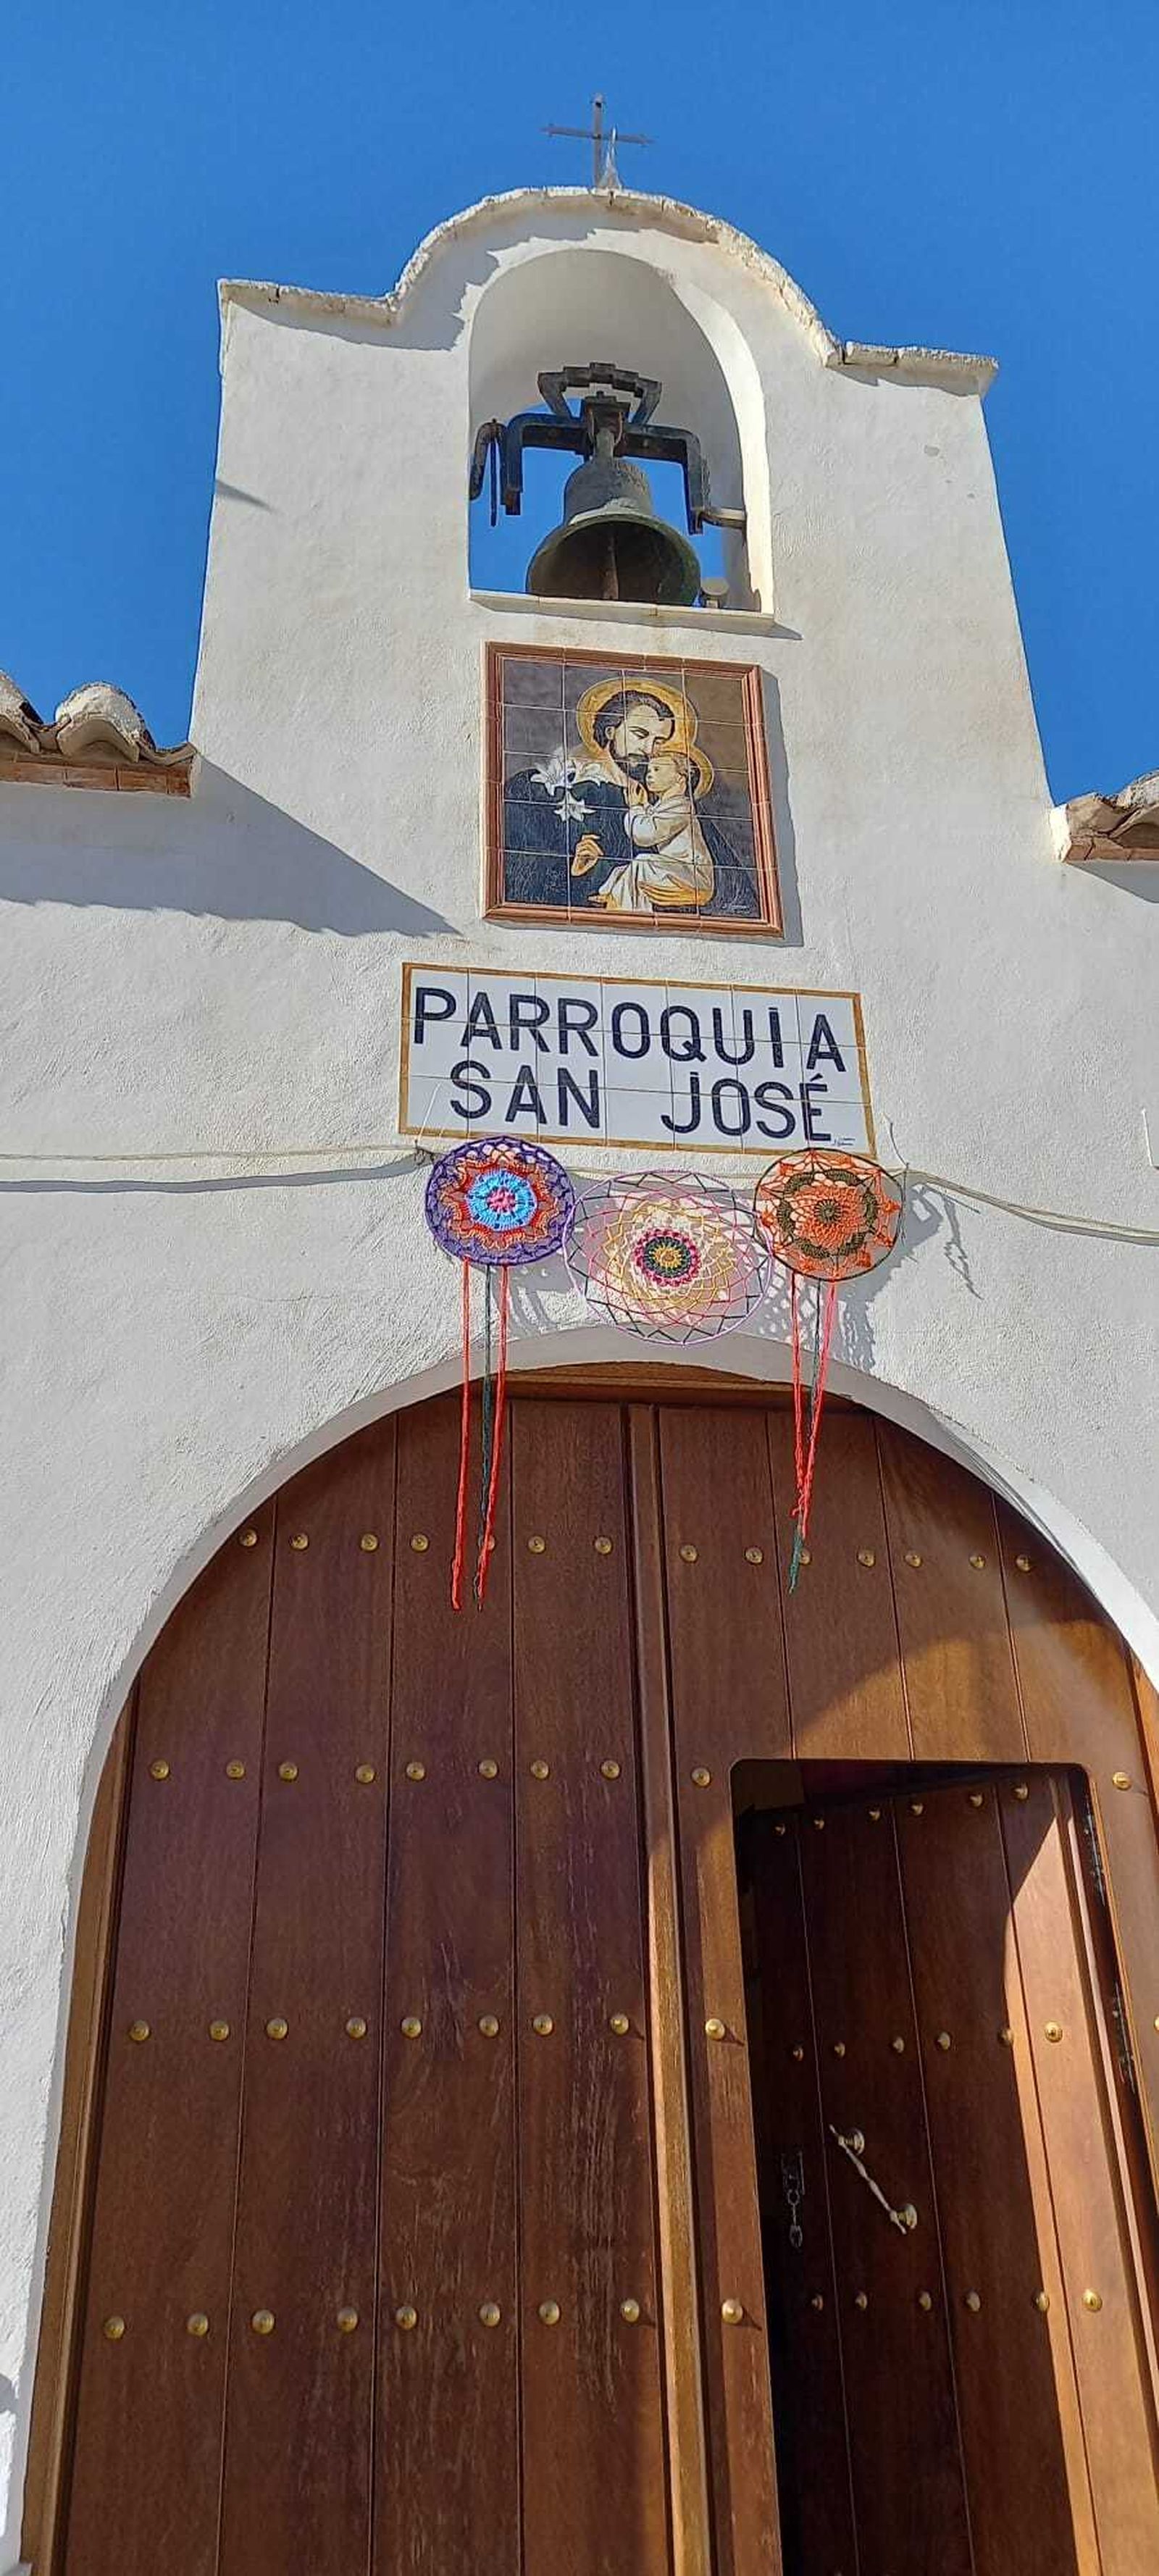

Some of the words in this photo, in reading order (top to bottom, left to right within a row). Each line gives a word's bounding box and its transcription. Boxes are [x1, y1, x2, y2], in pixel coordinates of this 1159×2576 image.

[414, 987, 847, 1072] PARROQUIA
[450, 1059, 601, 1129] SAN
[661, 1071, 832, 1142] JOSÉ
